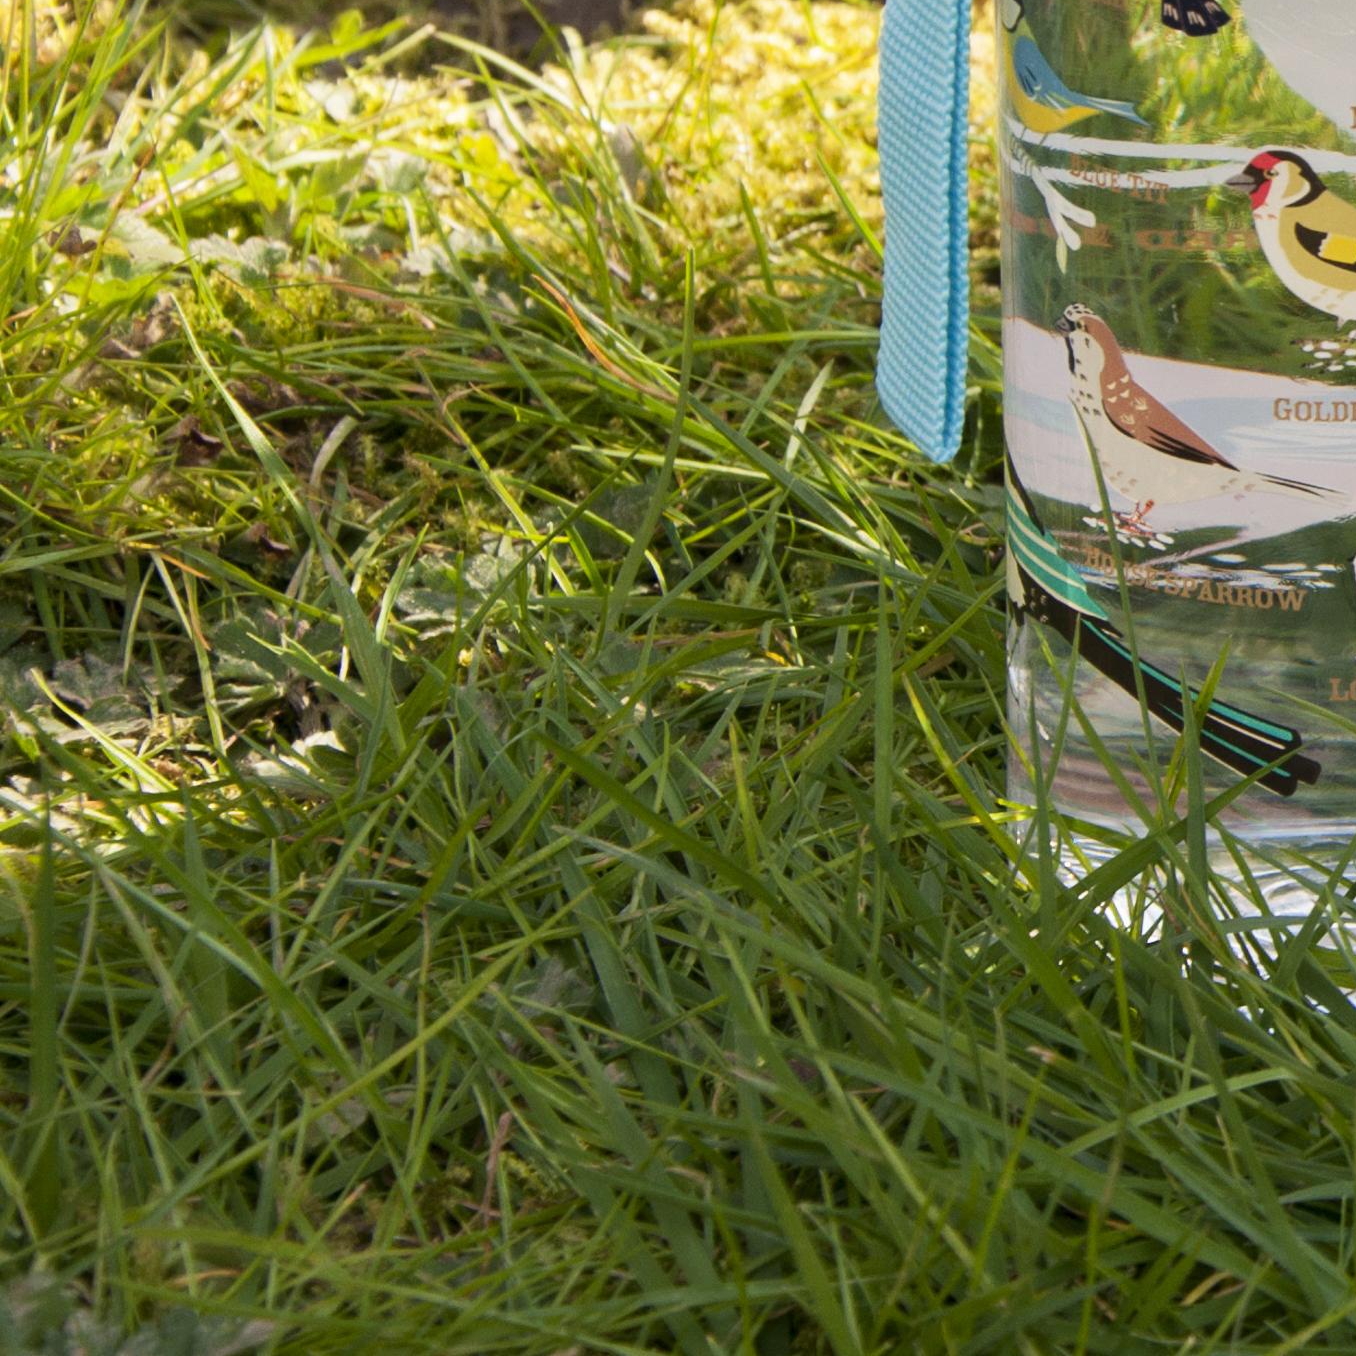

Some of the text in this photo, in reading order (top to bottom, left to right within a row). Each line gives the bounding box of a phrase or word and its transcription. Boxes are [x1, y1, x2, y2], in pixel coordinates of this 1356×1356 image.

[1069, 152, 1171, 204] BLUE TIT
[1164, 570, 1308, 612] SPARROW
